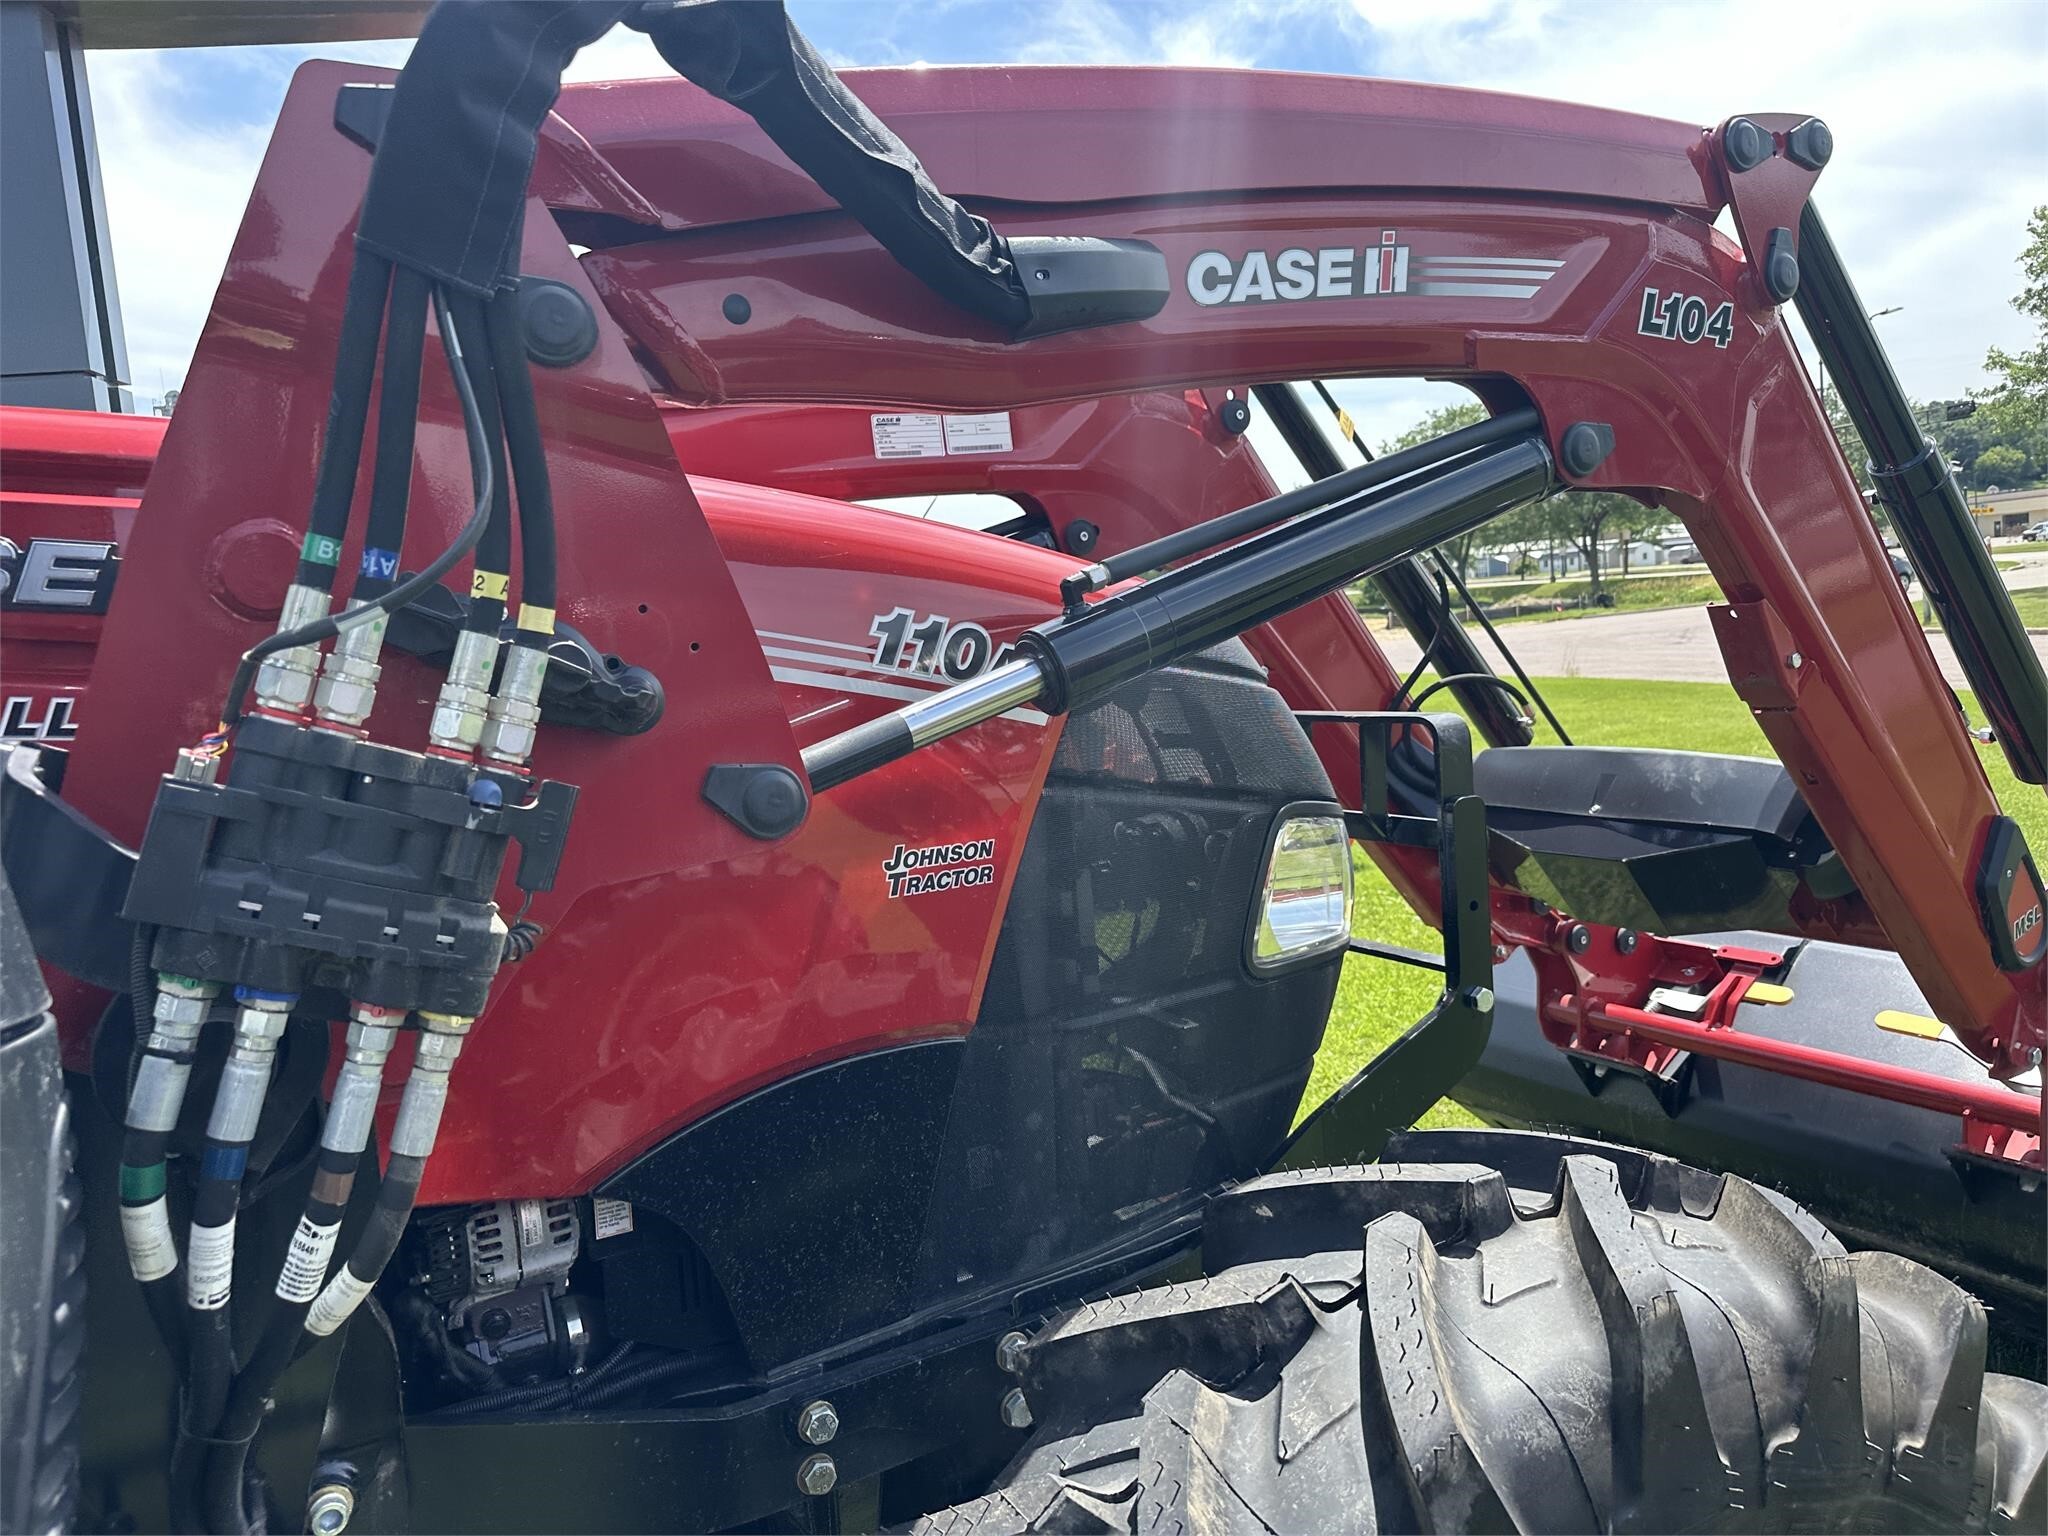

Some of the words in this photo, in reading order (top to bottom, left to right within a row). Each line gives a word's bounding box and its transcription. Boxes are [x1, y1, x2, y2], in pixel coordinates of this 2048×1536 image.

[1186, 248, 1355, 306] CASE
[1637, 287, 1734, 349] L104
[317, 539, 343, 561] B1
[0, 536, 113, 606] E
[882, 839, 995, 872] JOHNSON
[886, 864, 995, 898] TRACTOR
[2013, 904, 2042, 942] MSL
